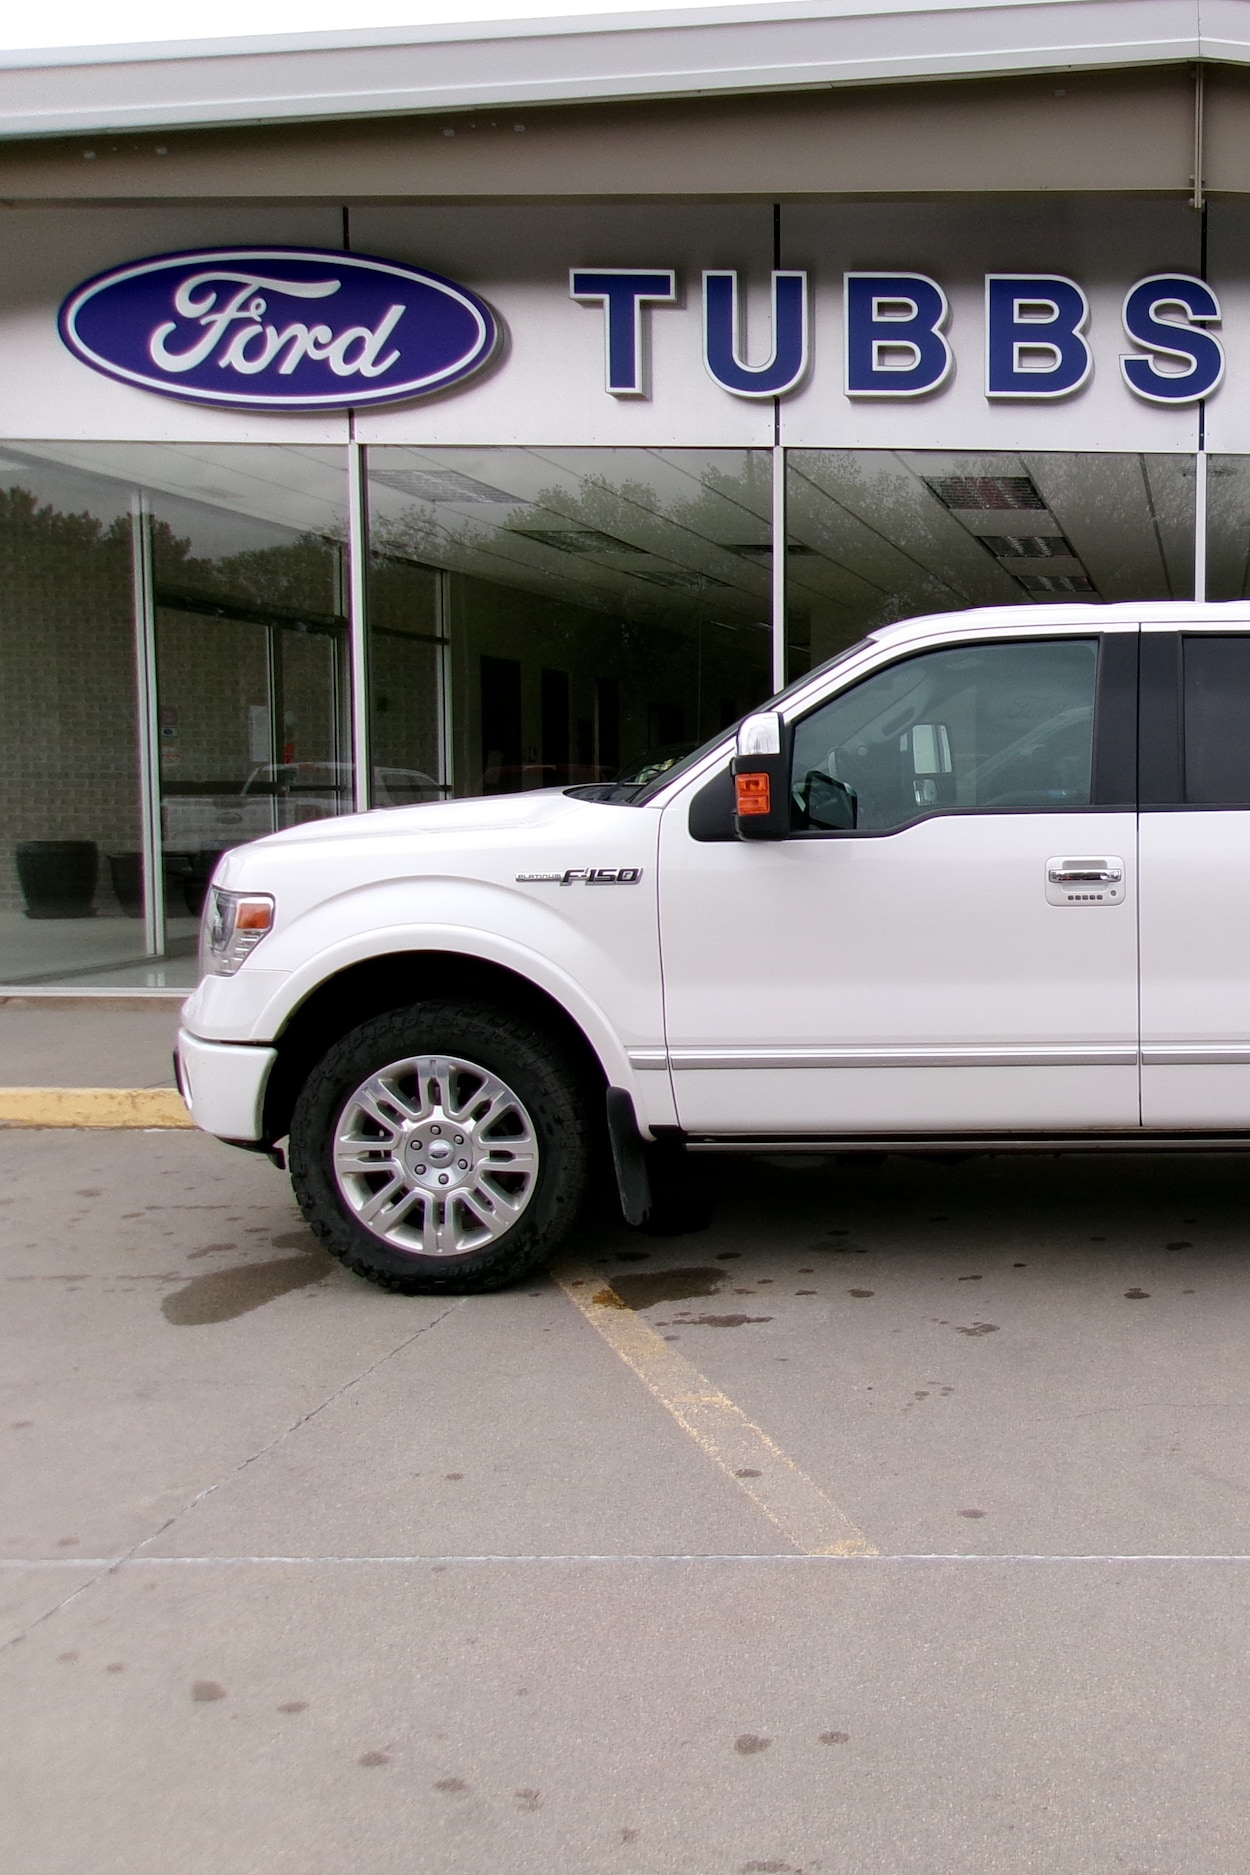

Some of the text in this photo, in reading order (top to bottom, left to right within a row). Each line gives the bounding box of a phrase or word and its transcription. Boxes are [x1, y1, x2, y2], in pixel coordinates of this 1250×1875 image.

[150, 271, 406, 377] Ford
[569, 268, 1226, 403] TUBBS
[561, 867, 641, 885] F-150
